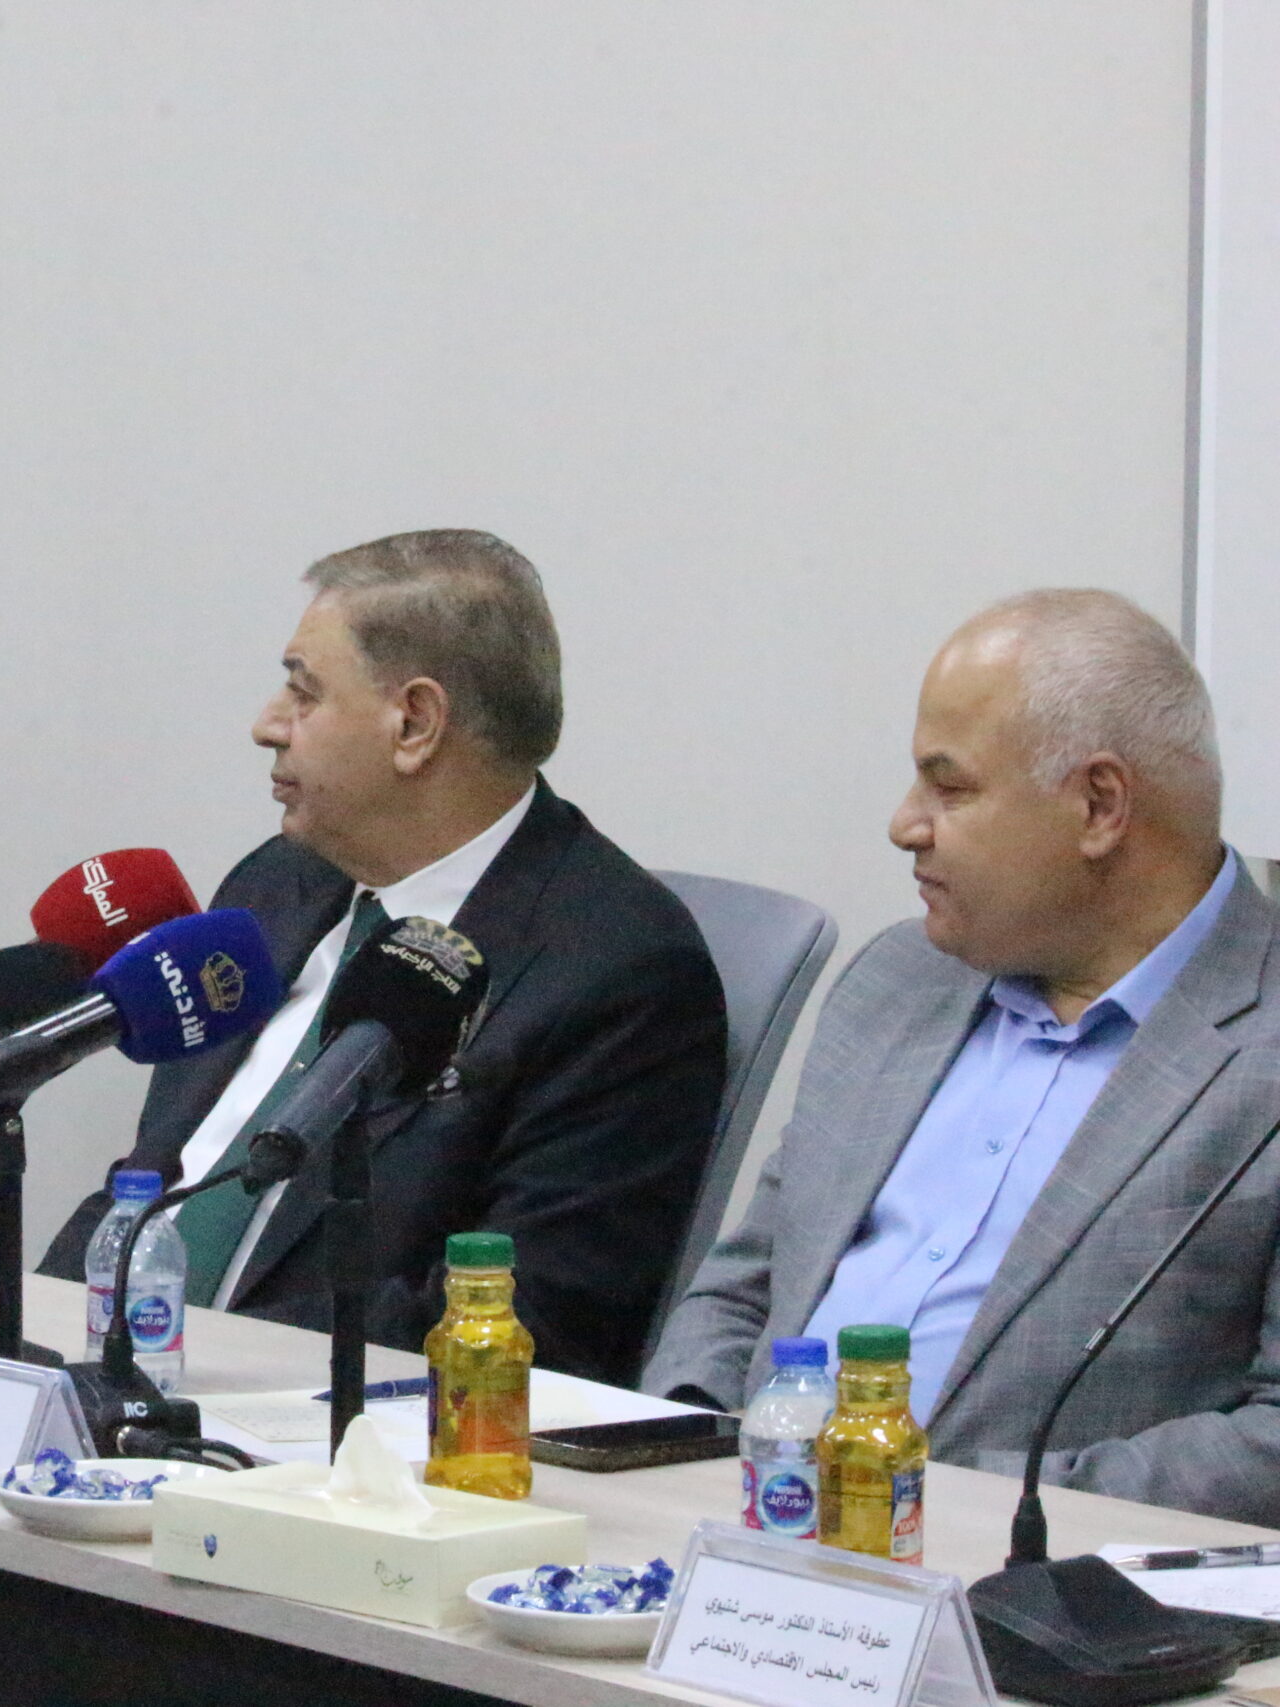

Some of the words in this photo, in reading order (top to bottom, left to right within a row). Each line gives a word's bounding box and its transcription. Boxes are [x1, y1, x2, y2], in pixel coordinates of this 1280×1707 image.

[82, 856, 129, 927] المملكة
[740, 1611, 774, 1625] موسى
[776, 1613, 815, 1631] الدكتور
[817, 1617, 854, 1641] الأستاذ
[857, 1624, 891, 1650] عطوفة
[690, 1636, 749, 1662] والاجتماعي
[750, 1649, 805, 1671] الاقتصادي
[805, 1660, 850, 1683] المجلس
[850, 1673, 880, 1694] رئيس
